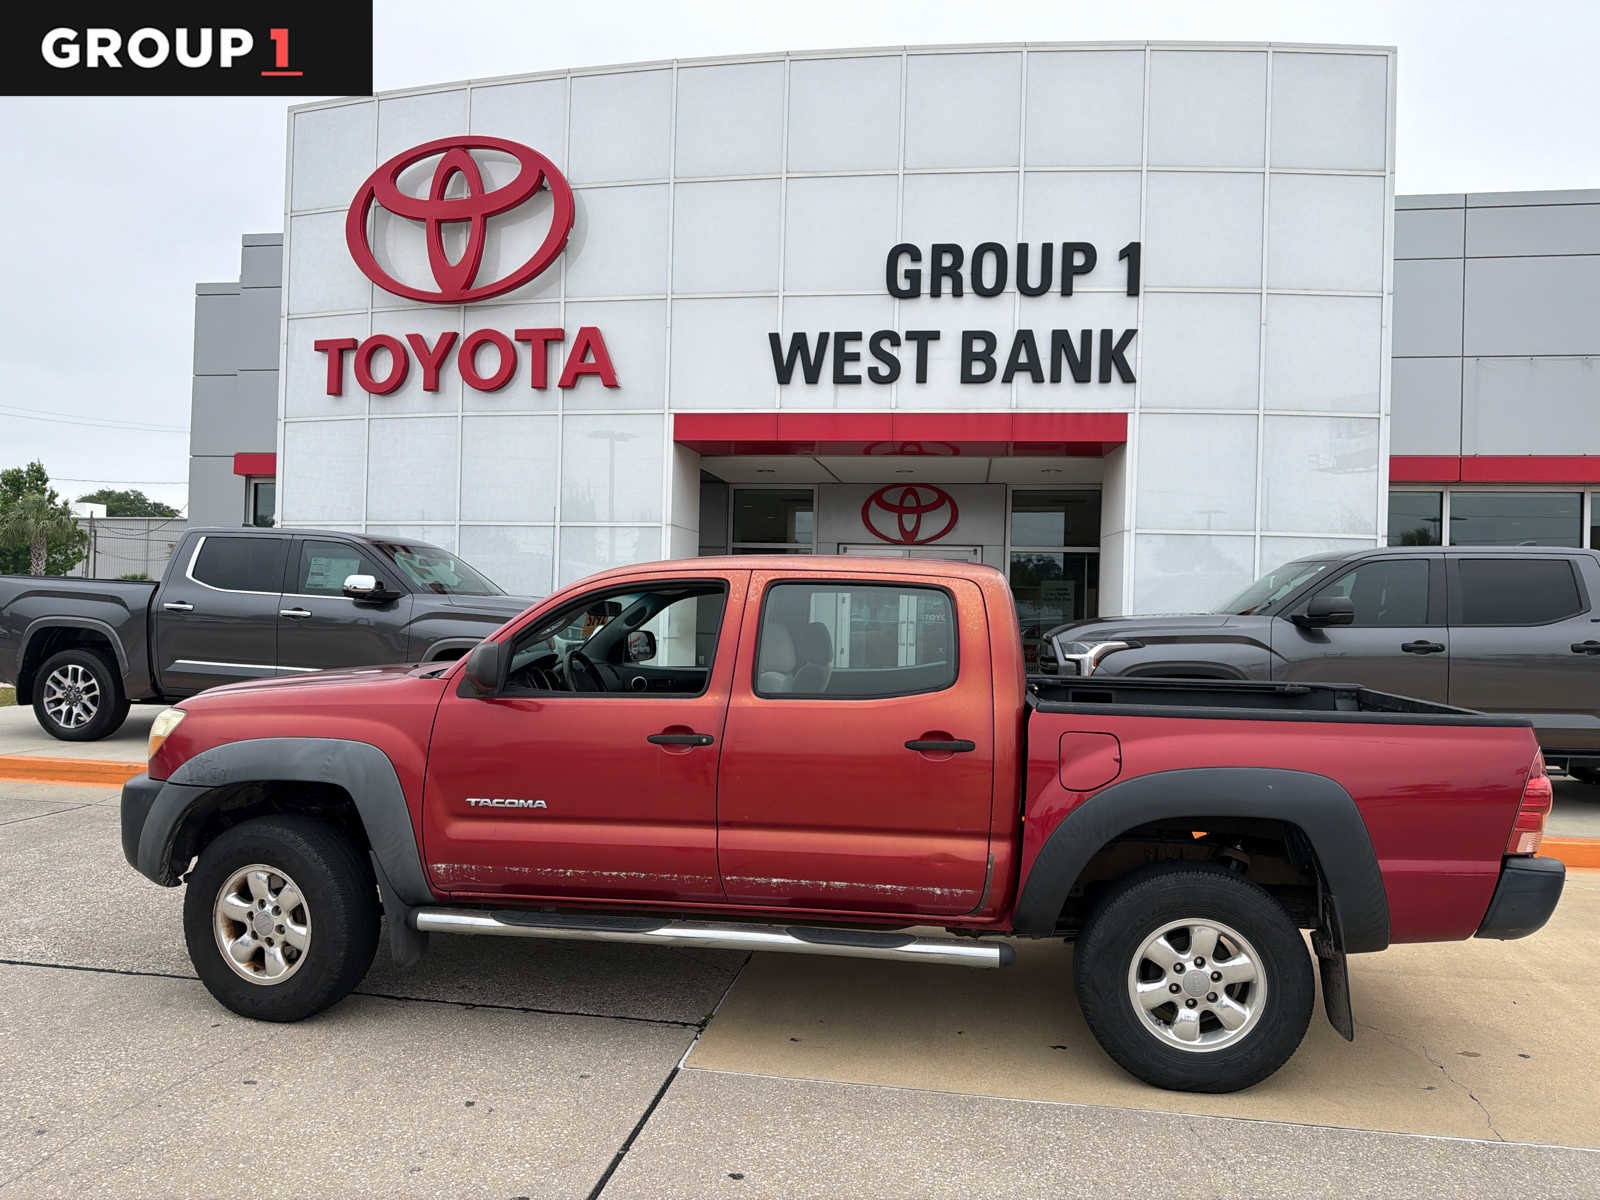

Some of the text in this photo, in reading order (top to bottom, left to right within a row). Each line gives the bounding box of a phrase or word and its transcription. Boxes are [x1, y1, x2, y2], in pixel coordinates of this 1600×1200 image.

[886, 242, 1141, 300] GROUP 1
[315, 327, 617, 394] TOYOTA
[769, 329, 1138, 385] WEST BANK
[466, 798, 547, 808] TACOMA
